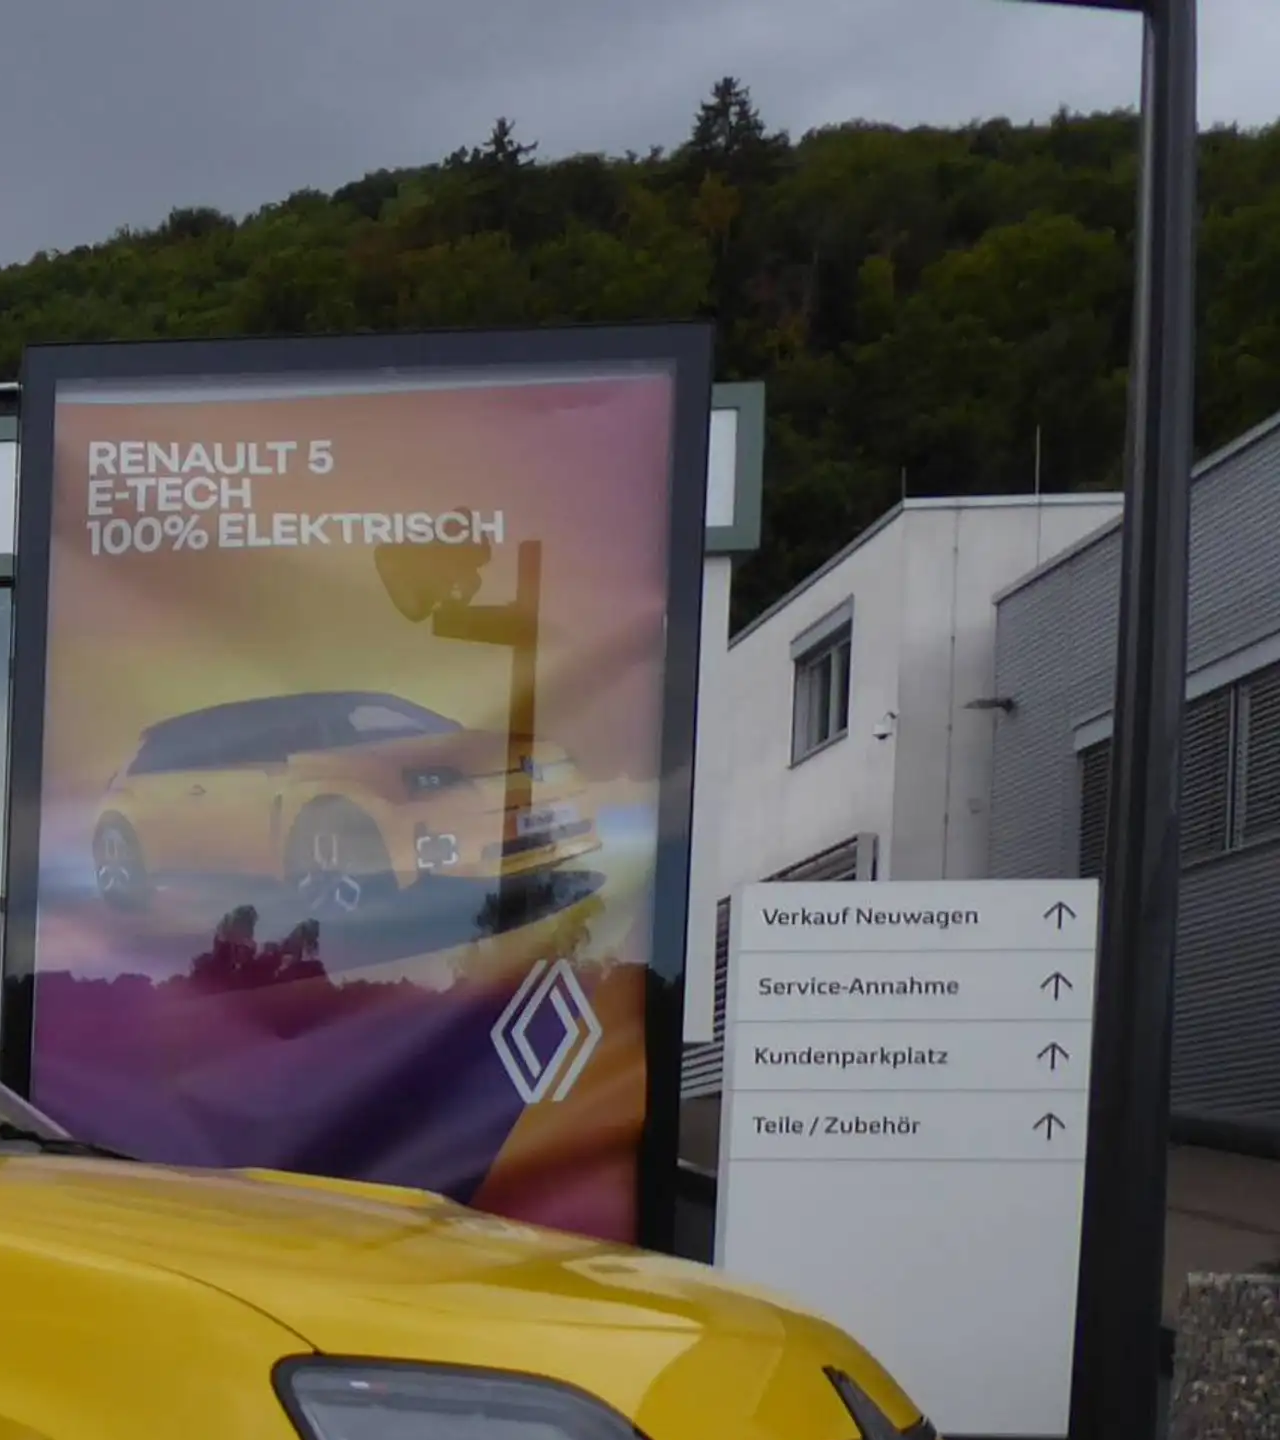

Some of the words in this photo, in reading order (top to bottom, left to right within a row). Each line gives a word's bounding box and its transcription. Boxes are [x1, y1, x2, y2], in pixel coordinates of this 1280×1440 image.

[88, 441, 298, 475] RENAULT
[307, 440, 334, 474] 5
[88, 476, 253, 516] E-TECH
[85, 515, 209, 556] 100%
[217, 509, 506, 548] ELEKTRISCH
[762, 907, 851, 926] Verkauf
[855, 908, 980, 930] Neuwagen
[758, 976, 960, 996] Service-Annahme
[753, 1046, 950, 1070] Kundenparkplatz
[752, 1115, 805, 1135] Teile
[823, 1116, 922, 1136] Zubehör
